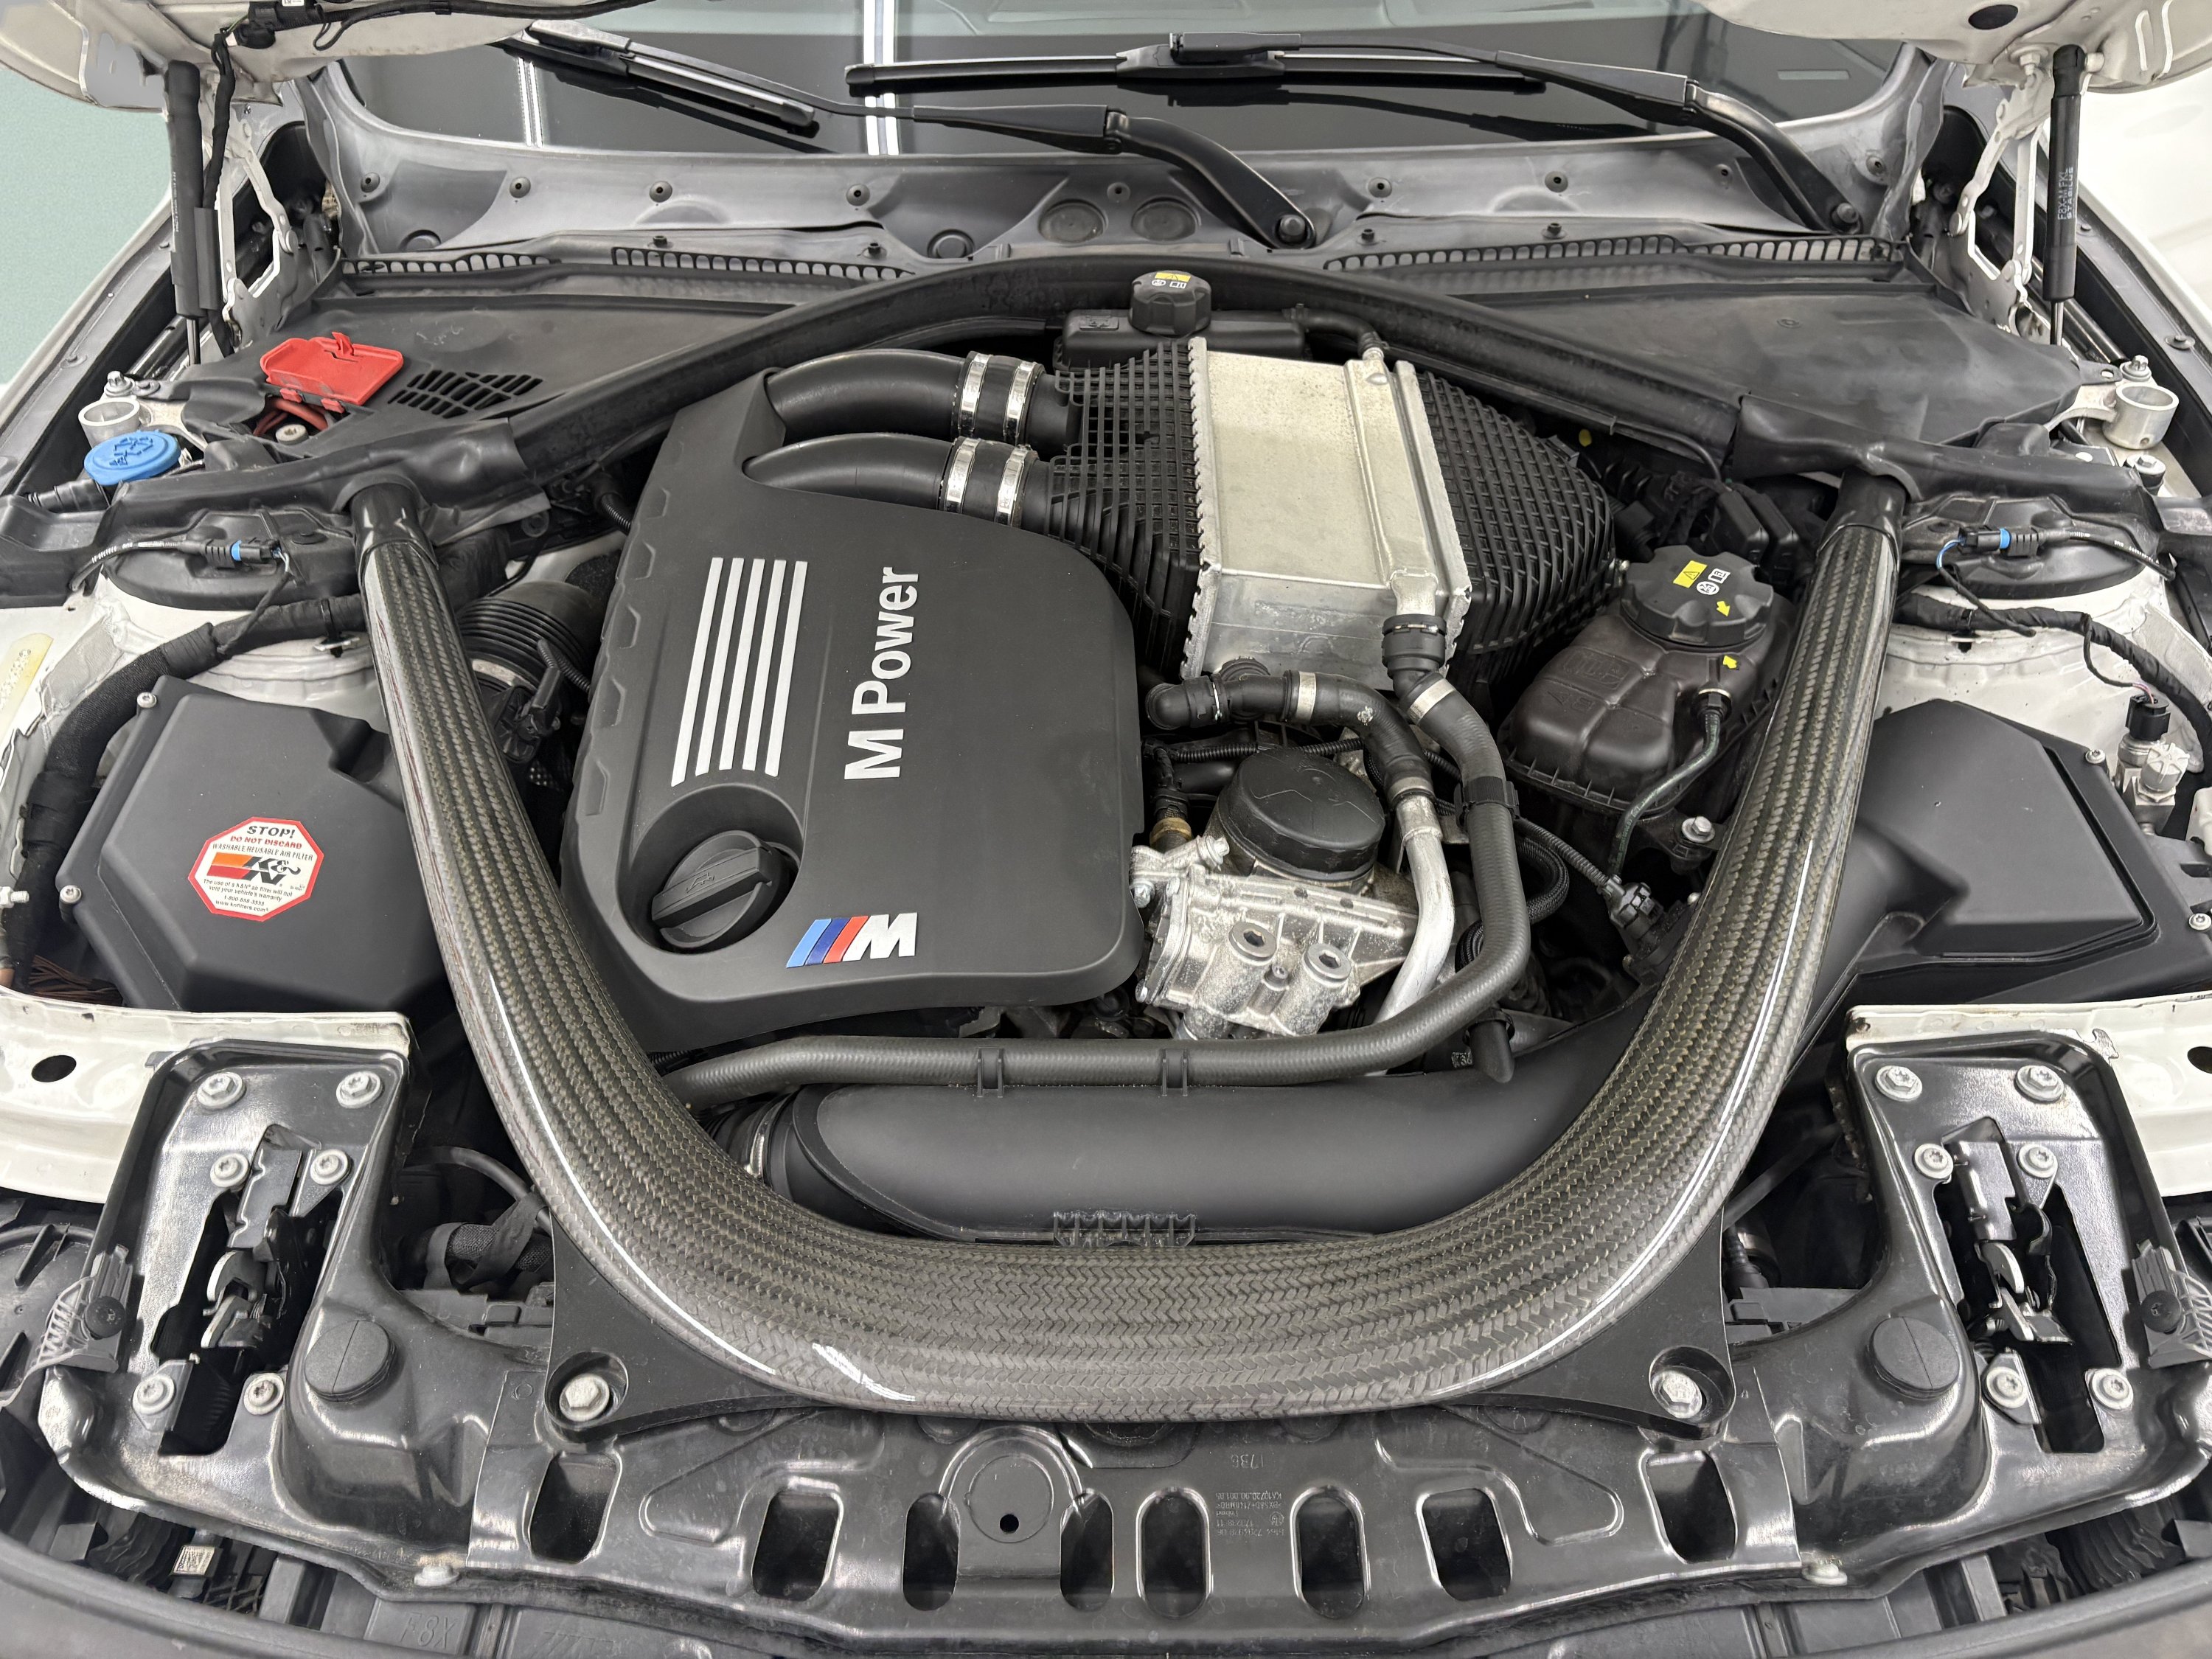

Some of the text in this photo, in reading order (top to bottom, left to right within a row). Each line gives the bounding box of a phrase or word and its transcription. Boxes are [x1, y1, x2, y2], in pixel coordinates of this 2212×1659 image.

[844, 566, 919, 780] M Power
[246, 825, 296, 839] STOP!
[264, 839, 302, 849] DISCARD
[279, 849, 291, 858] AIR
[292, 852, 313, 861] FILTER
[259, 893, 282, 902] warranty
